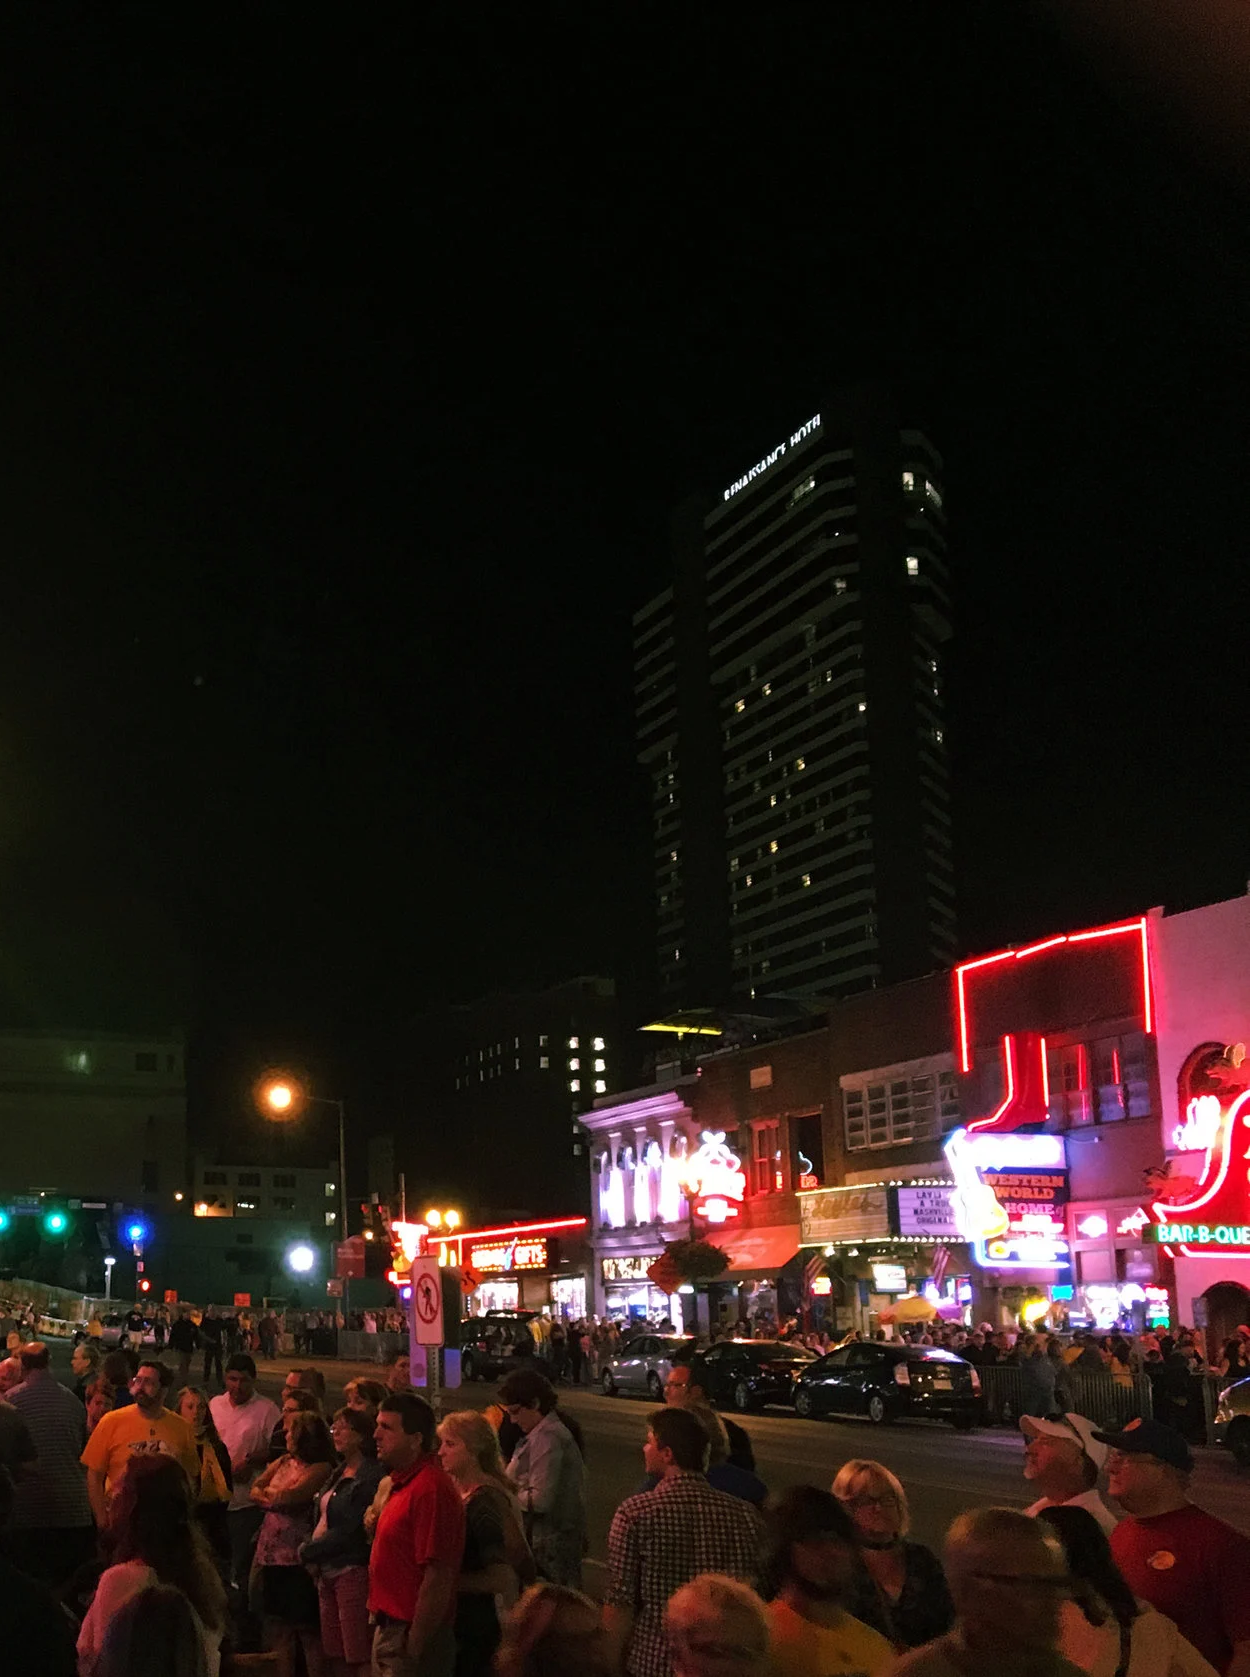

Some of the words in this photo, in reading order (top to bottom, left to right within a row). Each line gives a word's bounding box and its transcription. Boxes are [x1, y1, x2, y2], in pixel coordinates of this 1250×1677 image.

[982, 1173, 1065, 1188] WESTERN
[994, 1186, 1055, 1200] WORLD
[1004, 1202, 1055, 1215] HOME
[1158, 1224, 1250, 1245] BAR-B-QUE
